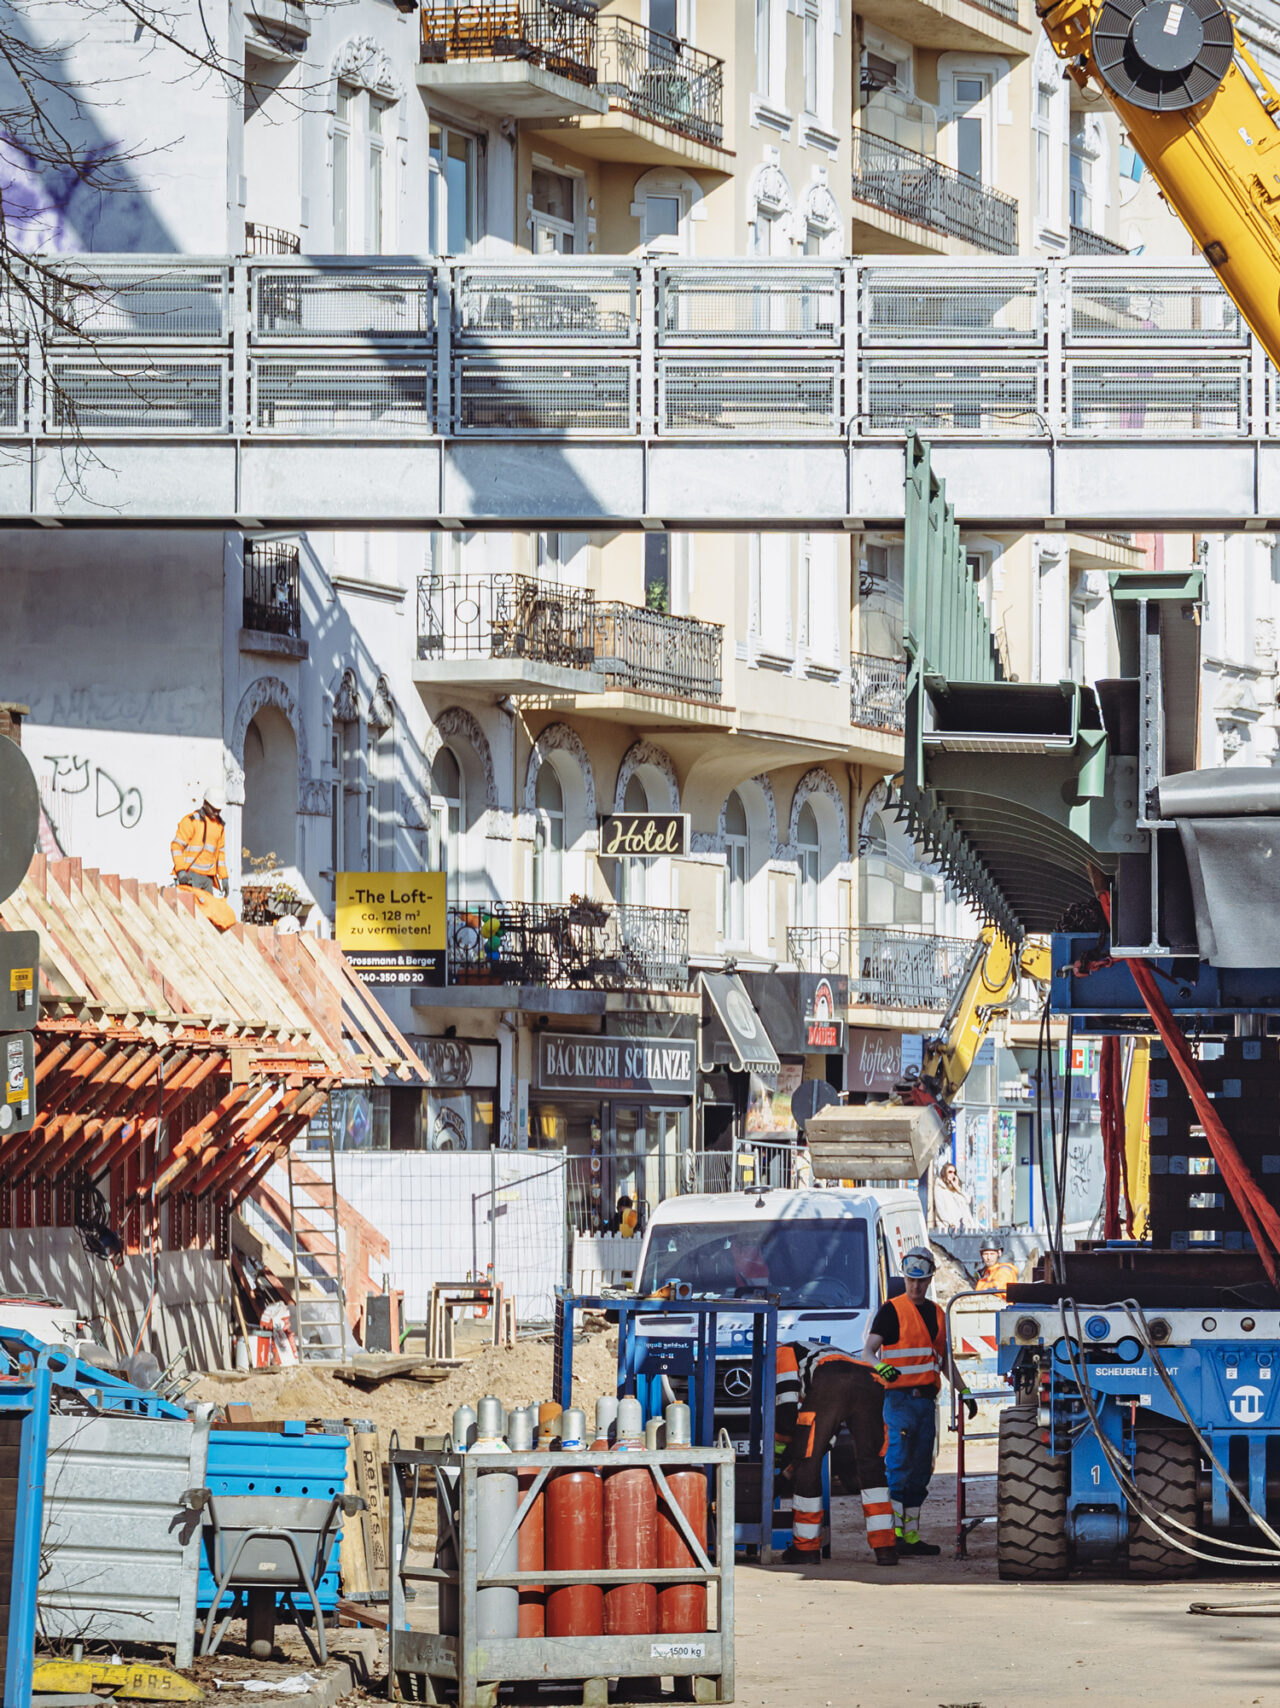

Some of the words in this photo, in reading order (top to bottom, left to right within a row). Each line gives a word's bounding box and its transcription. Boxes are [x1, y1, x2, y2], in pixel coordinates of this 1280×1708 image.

[606, 819, 679, 854] Hotel
[361, 912, 379, 921] ca.
[382, 910, 402, 921] 128
[351, 926, 364, 935] zu
[367, 924, 431, 935] vermieten!
[346, 955, 396, 966] Grossmann
[397, 955, 405, 966] &
[405, 955, 436, 967] Berger
[359, 973, 396, 982] 040-350
[399, 973, 411, 982] 80
[412, 973, 424, 982] 20
[546, 1038, 620, 1078] BÄCKEREI
[625, 1047, 691, 1081] SCHANZE
[1095, 1367, 1147, 1376] SCHEUERLE
[1153, 1367, 1179, 1376] SMT
[1091, 1465, 1100, 1485] 1
[363, 1450, 381, 1535] peters
[669, 1647, 688, 1655] 1500
[691, 1647, 702, 1657] kg
